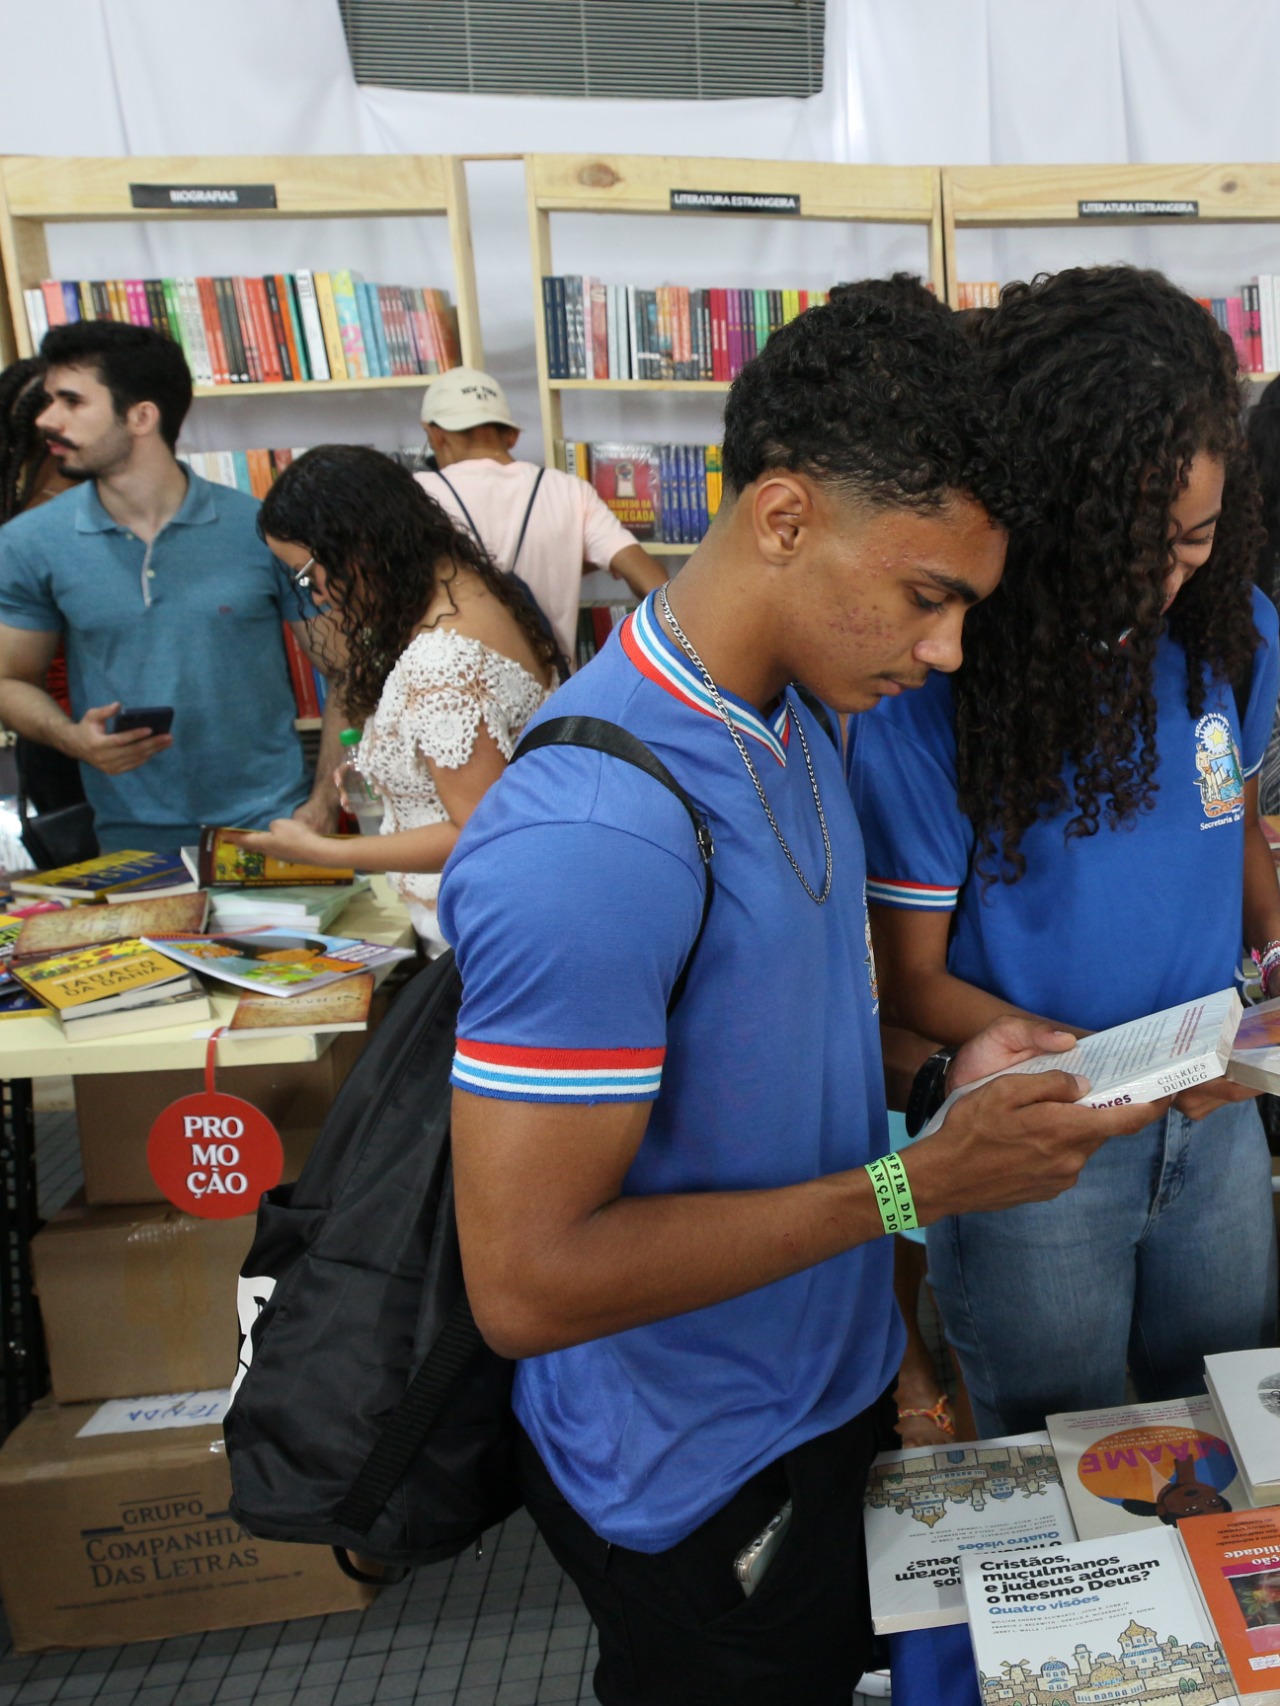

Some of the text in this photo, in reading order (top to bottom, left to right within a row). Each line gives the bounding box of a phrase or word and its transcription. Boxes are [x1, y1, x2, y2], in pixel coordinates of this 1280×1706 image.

[170, 190, 238, 203] BIOGRAFIAS
[674, 193, 796, 208] LITERATURA ESTRANGEIRA
[1082, 202, 1195, 213] LITERATURA ESTRANGEIRA
[1200, 816, 1233, 831] Secretaria
[101, 965, 165, 987] BAHIA
[1157, 1063, 1206, 1086] CHARLES
[1163, 1072, 1208, 1093] DUHIGG
[183, 1116, 244, 1139] PRO
[192, 1145, 240, 1167] MO
[186, 1168, 248, 1199] ÇÃO
[886, 1213, 898, 1231] DO
[900, 1202, 912, 1222] DA
[1082, 1439, 1230, 1475] MAAME
[122, 1500, 204, 1526] GRUPO
[957, 1536, 1006, 1551] visões
[1009, 1531, 1060, 1545] Quatro
[90, 1548, 259, 1588] DAS LETRAS
[980, 1554, 1070, 1572] Cristãos,
[982, 1554, 1121, 1583] muçulmanos
[984, 1583, 998, 1593] e
[1000, 1574, 1075, 1595] judeus
[1078, 1558, 1160, 1582] adoram
[986, 1570, 1151, 1604] o mesmo Deus?
[988, 1593, 1100, 1615] Quatro visões
